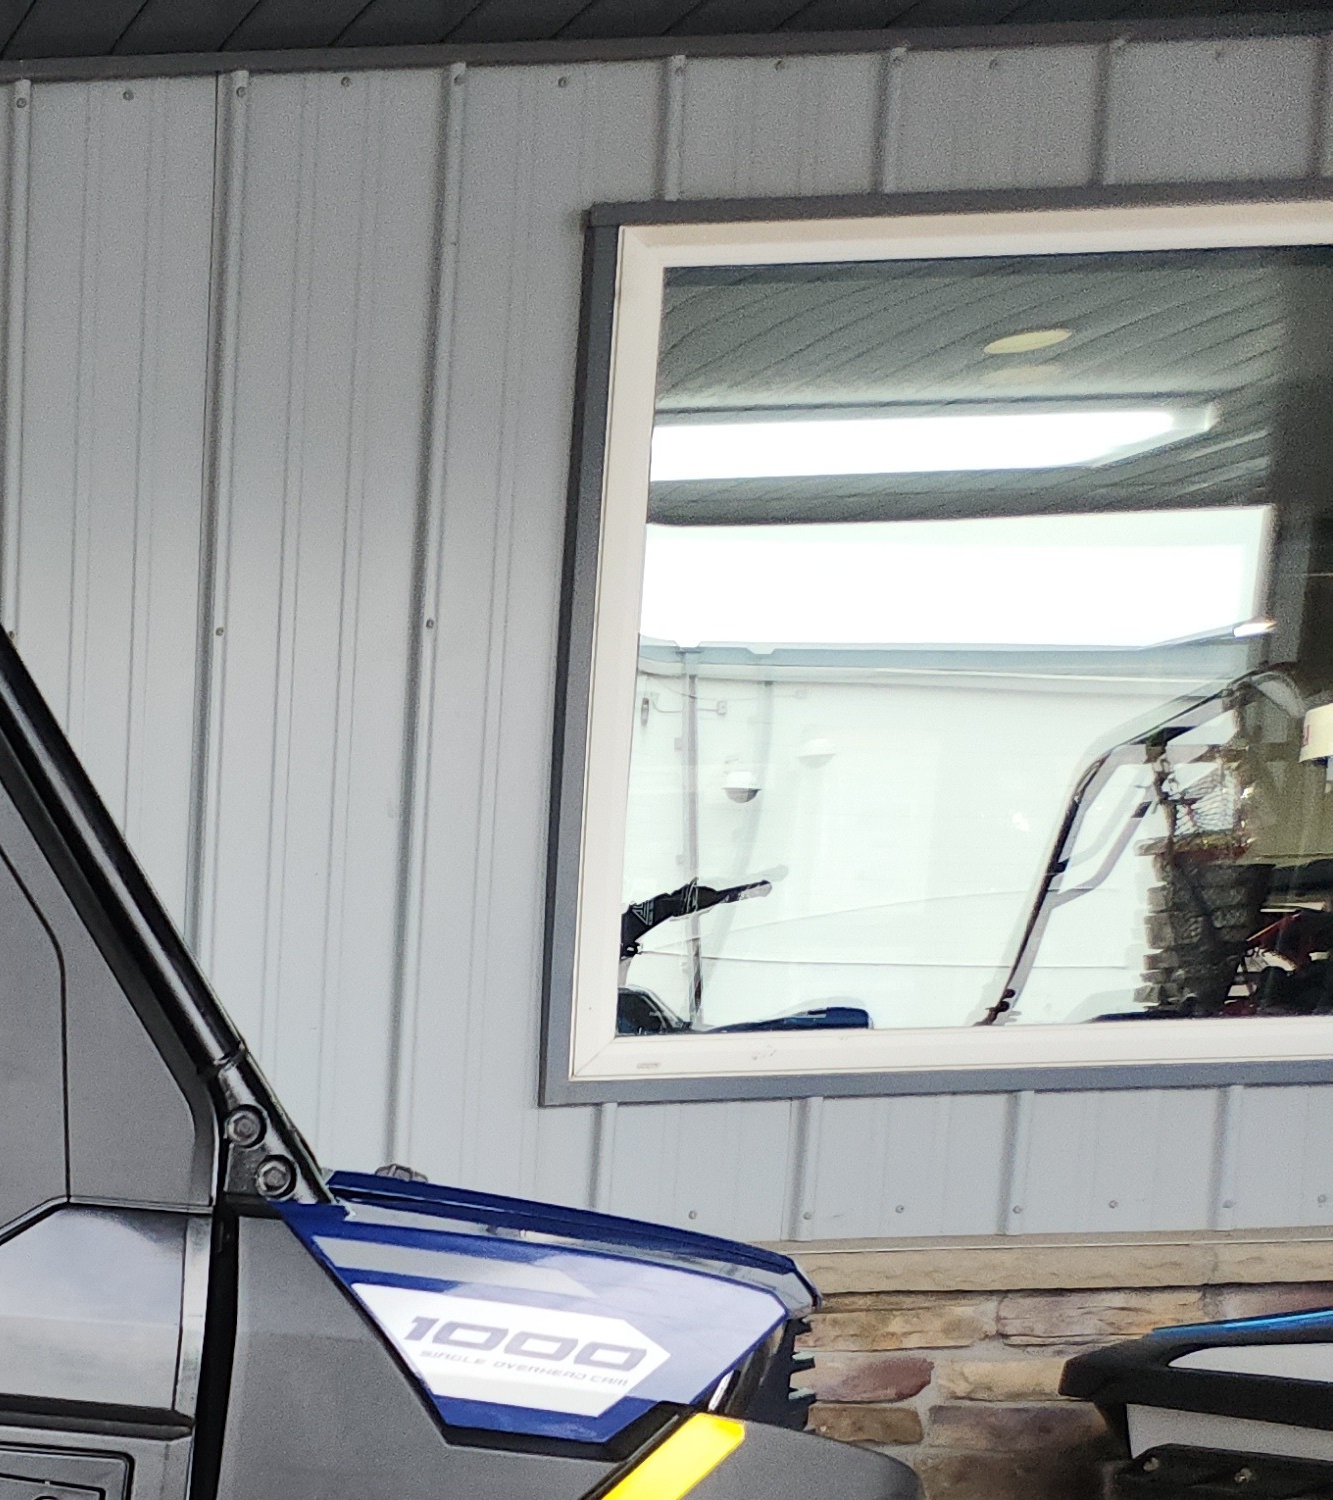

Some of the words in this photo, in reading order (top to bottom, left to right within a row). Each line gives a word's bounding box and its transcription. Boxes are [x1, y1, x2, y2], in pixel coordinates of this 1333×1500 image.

[404, 1316, 648, 1372] 1000
[419, 1349, 487, 1366] SINGLE
[492, 1359, 587, 1381] OVERHEAD
[590, 1374, 629, 1387] CAM
